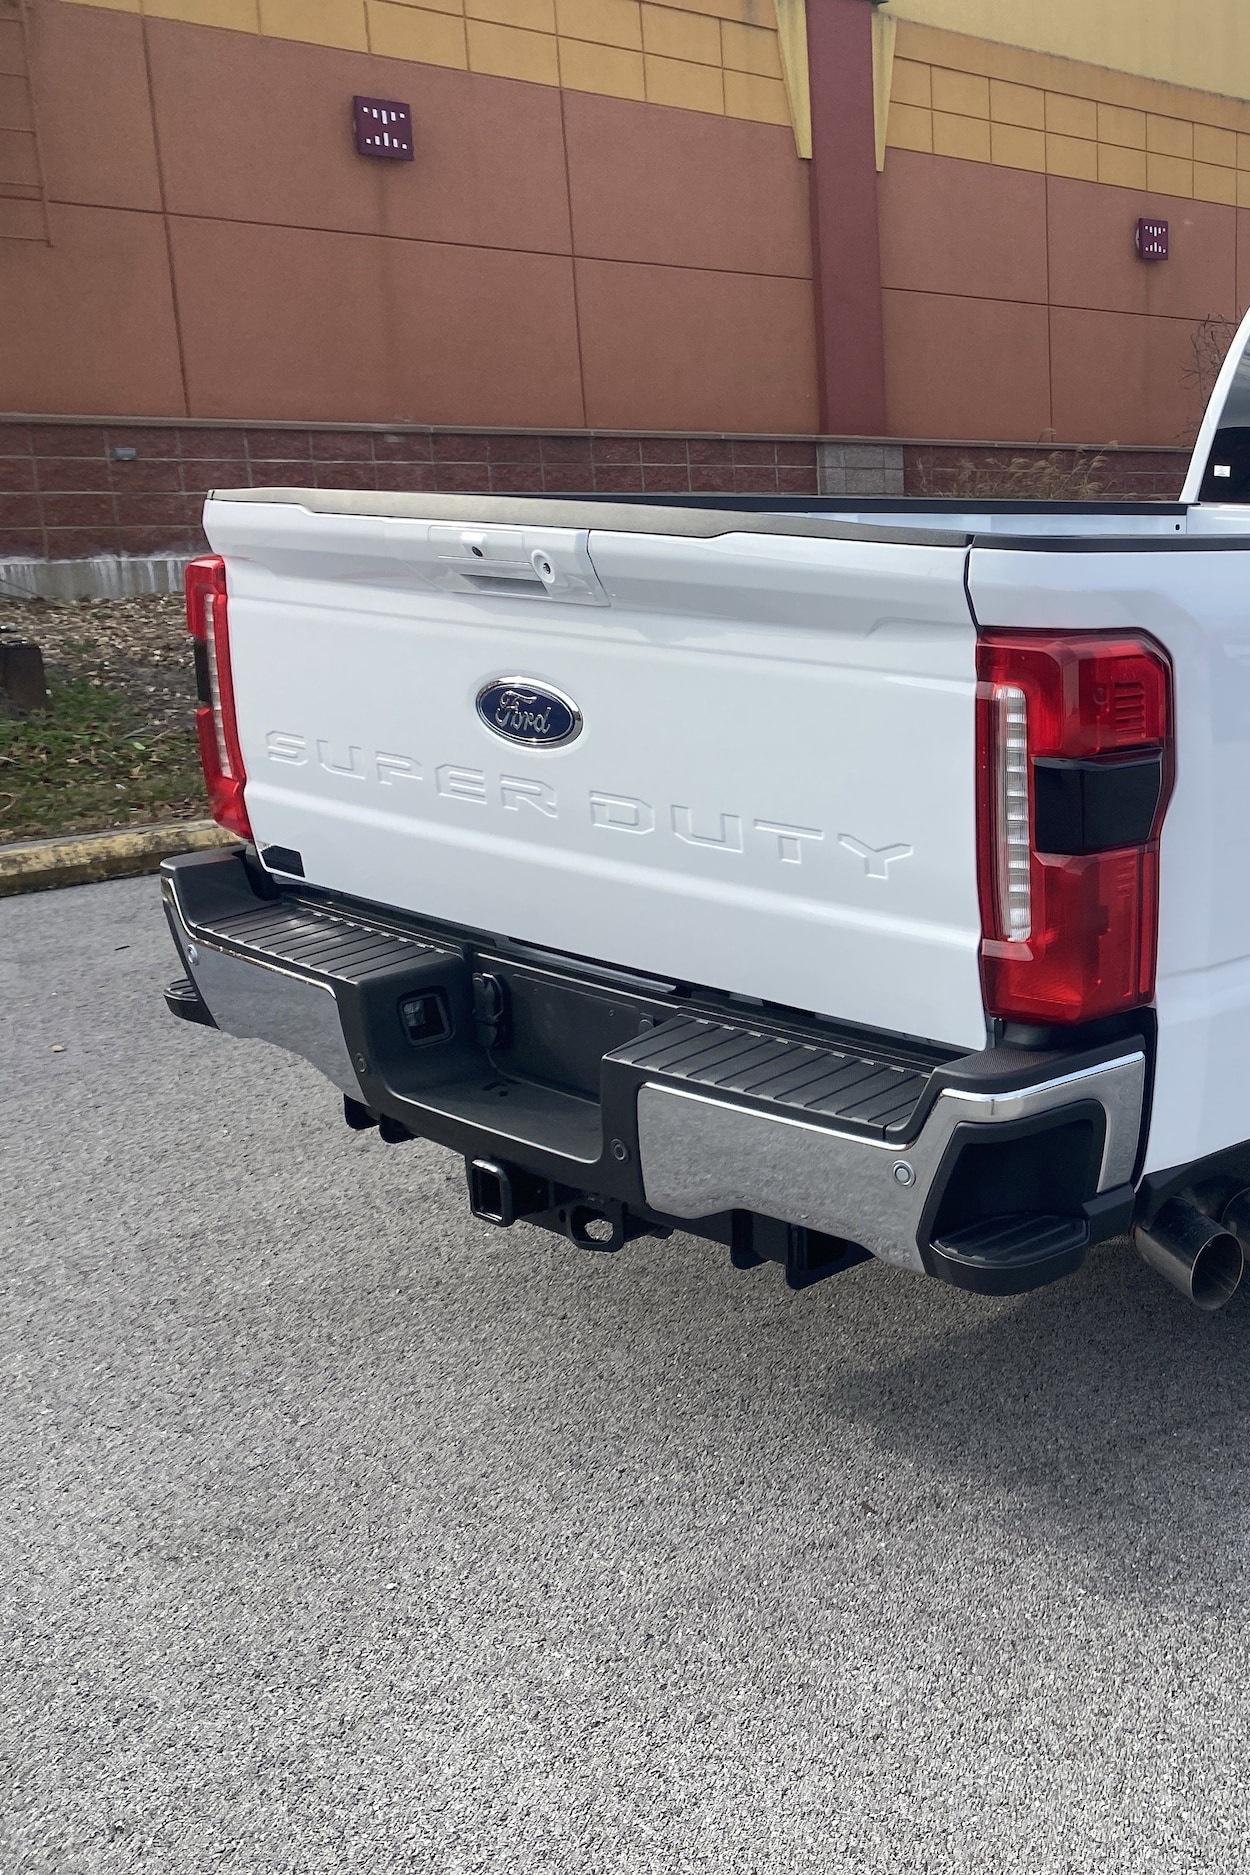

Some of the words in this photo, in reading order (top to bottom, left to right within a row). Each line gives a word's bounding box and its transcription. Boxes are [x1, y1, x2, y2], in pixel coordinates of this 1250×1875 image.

[495, 690, 551, 734] Ford
[266, 730, 559, 818] SUPER
[589, 790, 914, 879] DUTY
